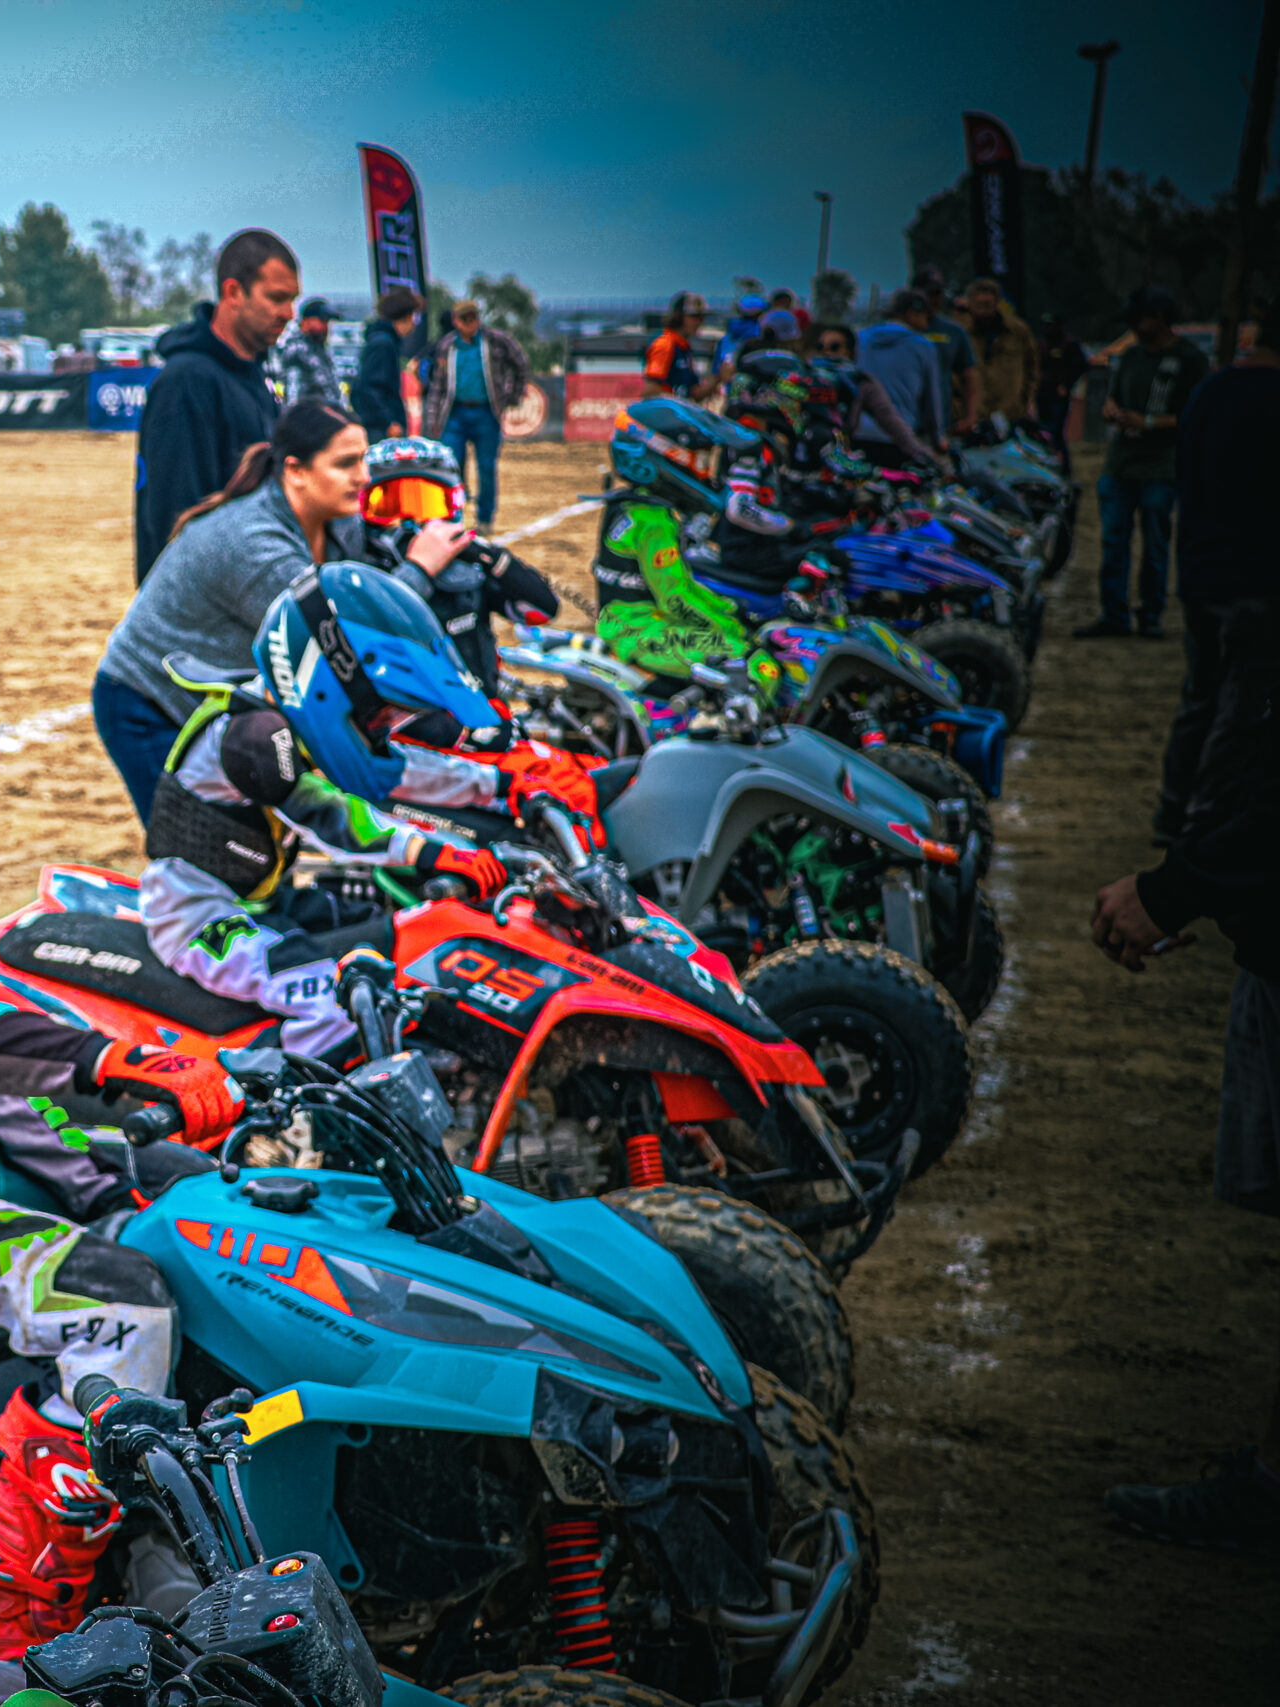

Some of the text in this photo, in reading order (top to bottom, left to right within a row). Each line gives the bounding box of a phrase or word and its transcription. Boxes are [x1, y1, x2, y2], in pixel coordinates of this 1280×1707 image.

[268, 606, 302, 708] THOR
[61, 1317, 139, 1351] FOX
[217, 1271, 376, 1347] RENEGADE
